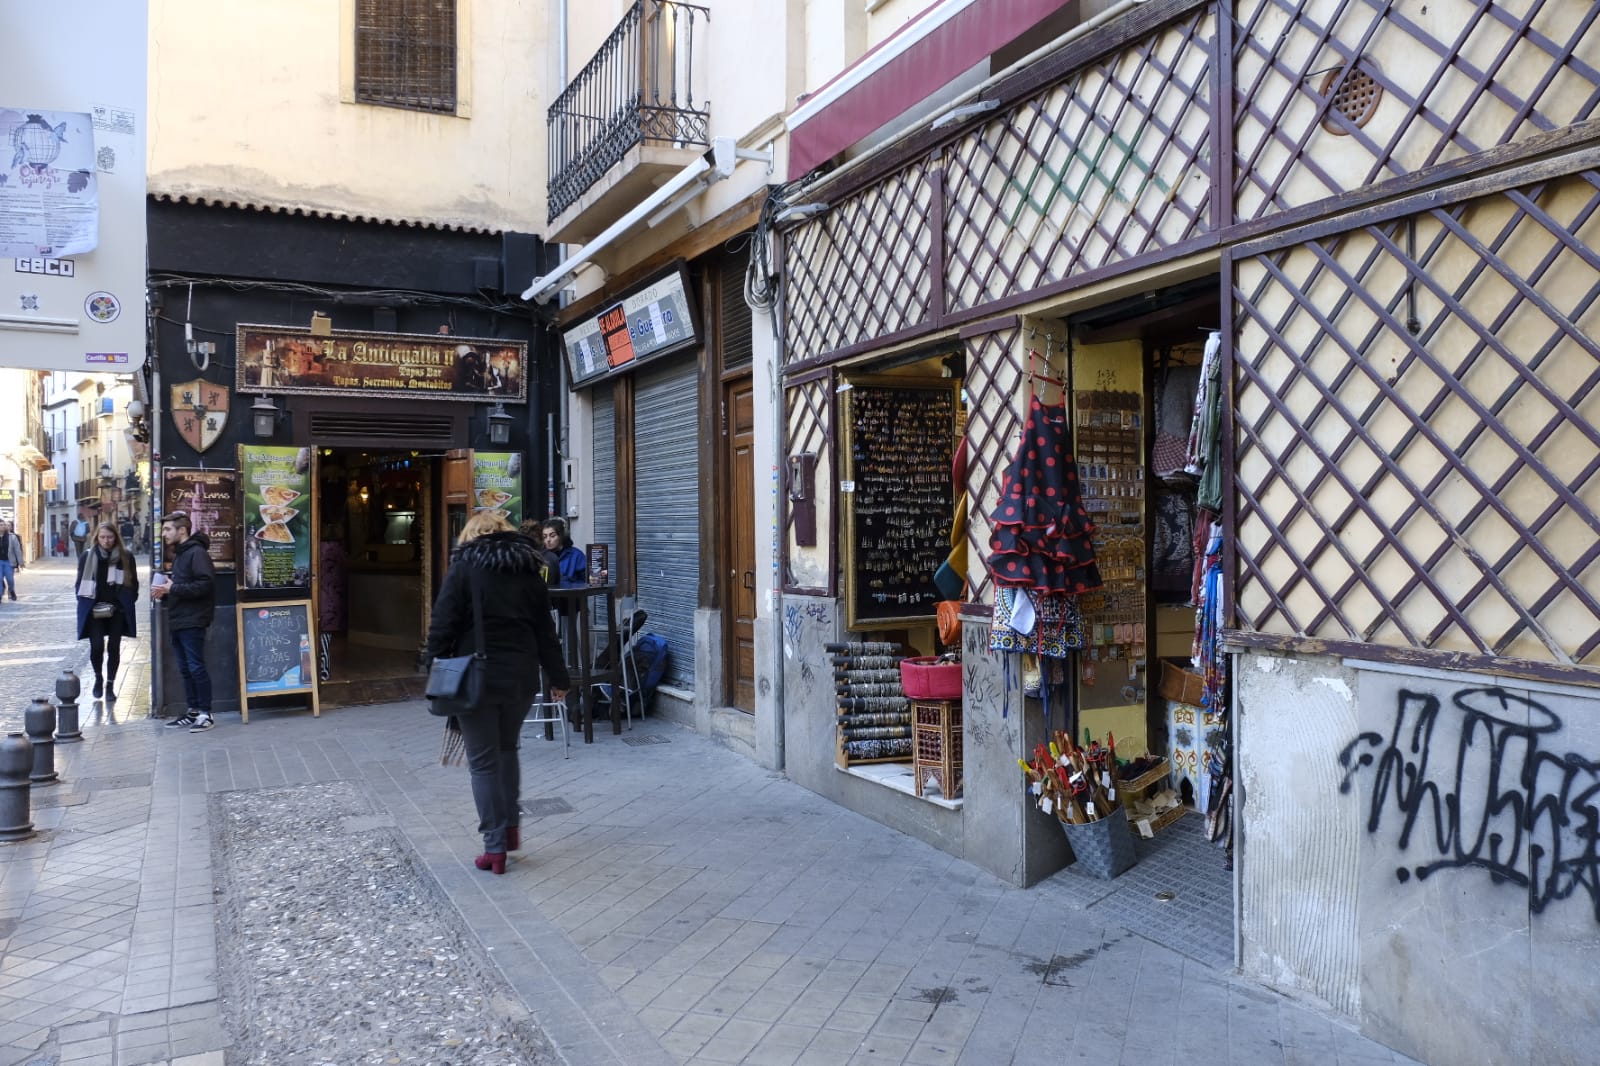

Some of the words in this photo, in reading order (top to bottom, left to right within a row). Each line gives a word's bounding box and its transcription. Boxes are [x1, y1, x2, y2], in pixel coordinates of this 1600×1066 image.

[322, 340, 347, 361] La
[353, 341, 441, 365] Antigualla
[427, 367, 442, 377] Bar
